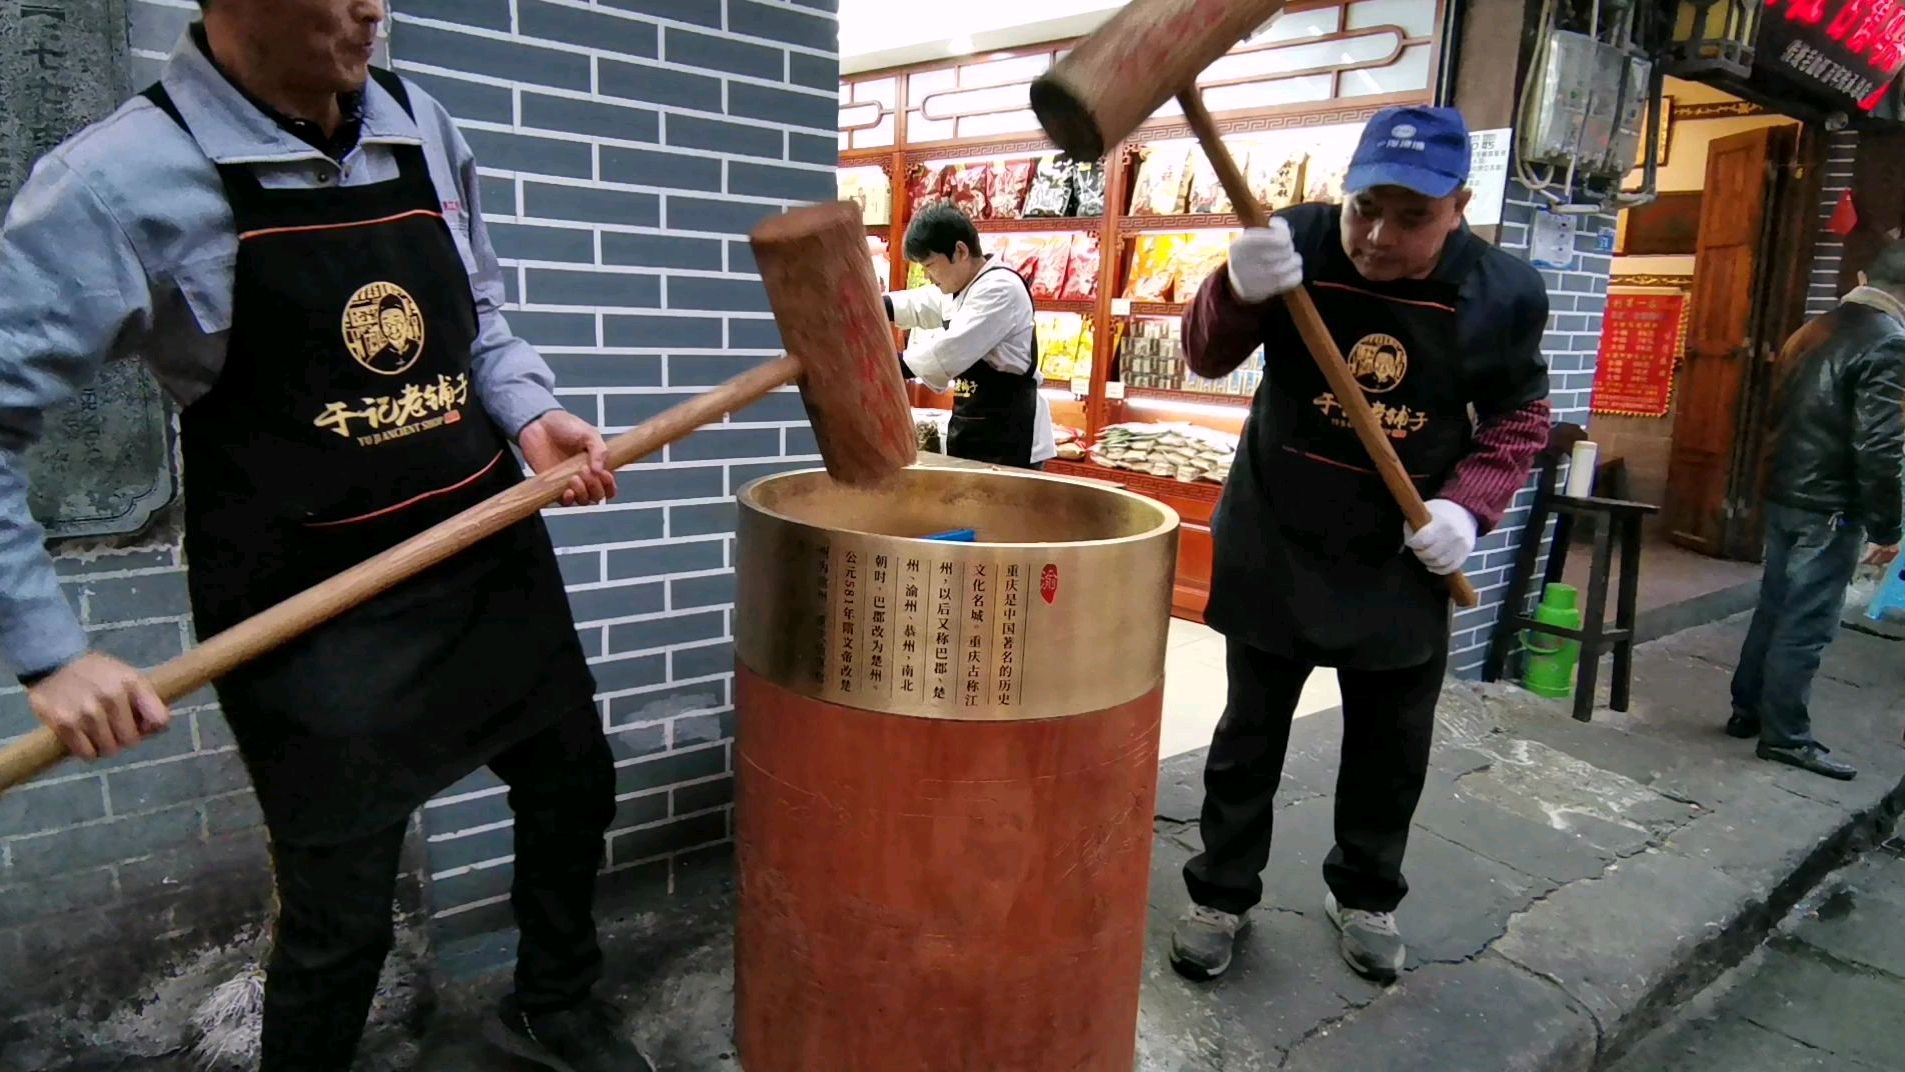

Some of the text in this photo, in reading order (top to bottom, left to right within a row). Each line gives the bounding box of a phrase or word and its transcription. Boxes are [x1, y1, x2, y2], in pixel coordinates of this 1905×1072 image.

[382, 423, 421, 441] ANCIENT
[998, 563, 1020, 706] 重庆是中国著名的历史
